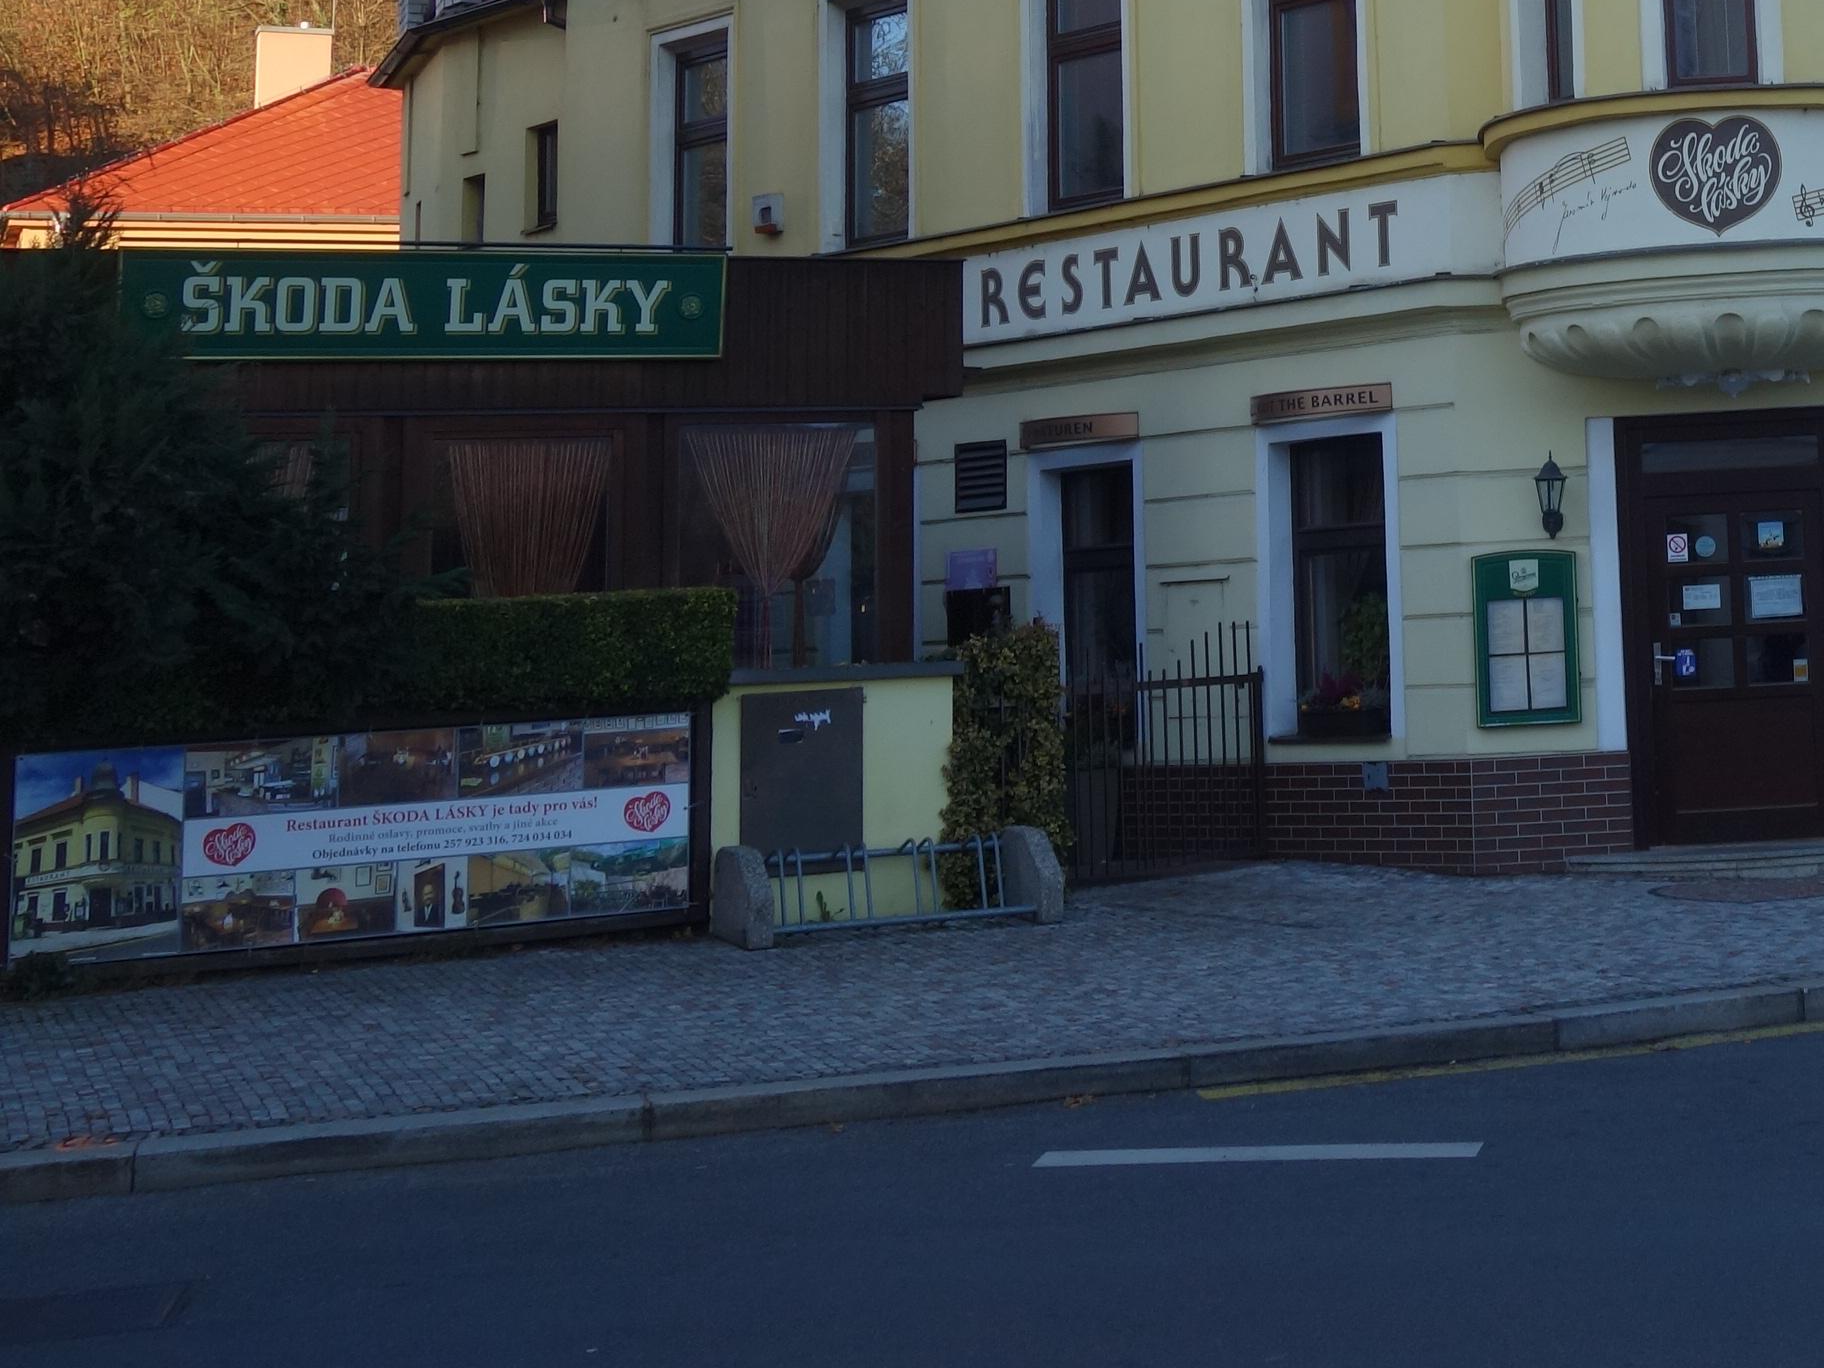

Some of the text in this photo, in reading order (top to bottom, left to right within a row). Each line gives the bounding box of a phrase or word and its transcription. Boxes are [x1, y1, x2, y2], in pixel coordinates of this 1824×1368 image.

[1658, 124, 1760, 202] Škoda
[1690, 153, 1772, 223] lásky
[981, 200, 1398, 328] RESTAURANT
[181, 260, 672, 335] ŠKODA LÁSKY
[1280, 397, 1305, 411] THE
[1311, 390, 1379, 408] BARREL
[286, 796, 598, 832] Restaurant ŠKODA LÁSKY je tady pro vás!
[328, 831, 375, 843] Rodinné
[535, 817, 559, 826] akce
[312, 845, 378, 861] Objednávky
[381, 846, 394, 854] na
[397, 841, 441, 853] telefonu
[444, 838, 463, 849] 257
[465, 837, 484, 848] 923
